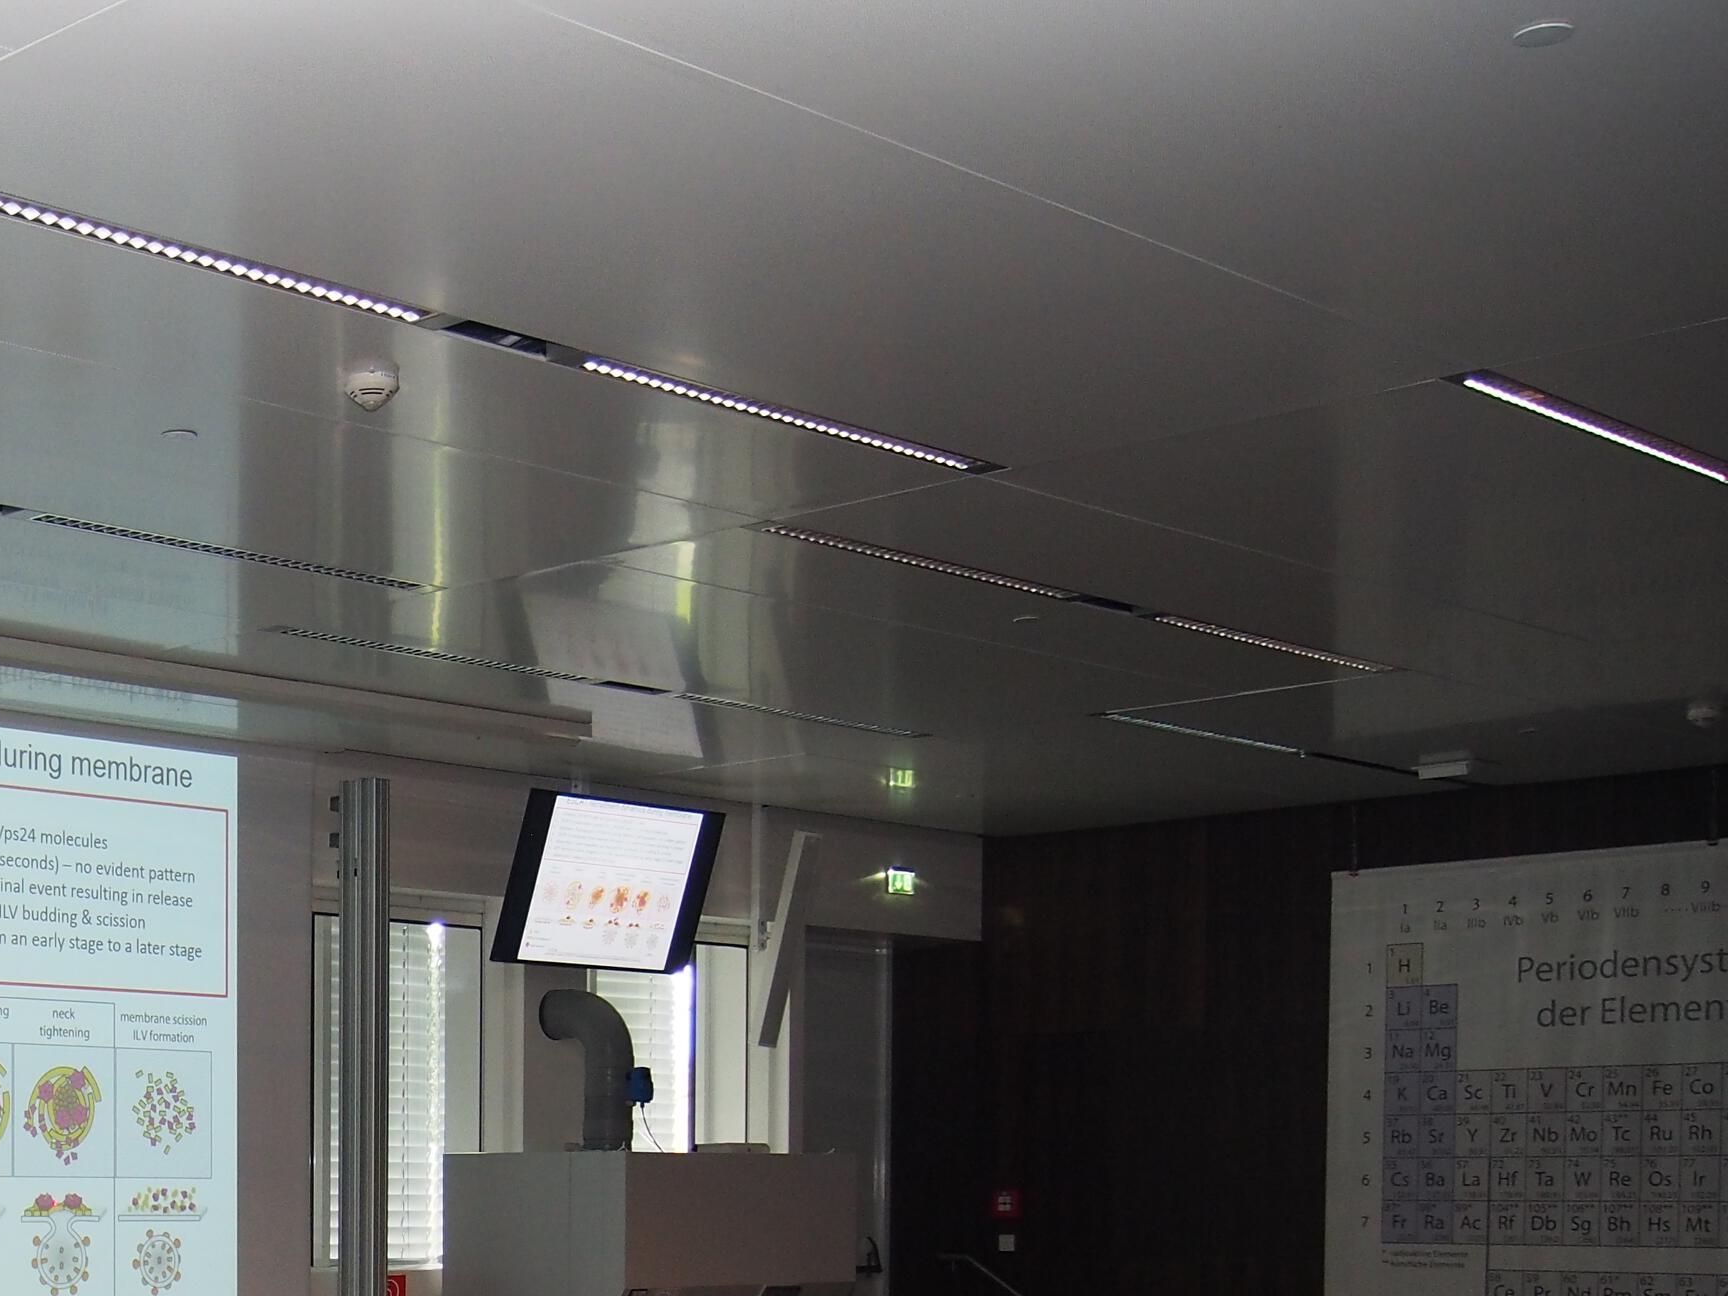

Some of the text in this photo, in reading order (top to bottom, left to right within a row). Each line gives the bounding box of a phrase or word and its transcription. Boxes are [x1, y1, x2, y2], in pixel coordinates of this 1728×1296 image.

[71, 755, 192, 788] membrane
[40, 829, 108, 850] molecules
[0, 854, 59, 875] seconds)
[75, 862, 92, 874] no
[95, 860, 145, 879] evident
[148, 867, 195, 886] pattern
[22, 903, 78, 928] budding
[81, 908, 92, 925] &
[96, 912, 146, 929] scission
[1399, 961, 1410, 973] H
[52, 1007, 75, 1020] neck
[1397, 1000, 1410, 1015] Li
[1429, 1000, 1448, 1014] Be
[1537, 996, 1728, 1028] der Elemen
[120, 1011, 207, 1026] membrane scission
[39, 1024, 90, 1042] tightening
[132, 1029, 194, 1043] ILV formation
[1392, 1045, 1413, 1058] Na
[1425, 1043, 1451, 1061] Mg
[1397, 1087, 1408, 1100] K
[1427, 1086, 1448, 1101] Ca
[1464, 1086, 1482, 1100] Sc
[1503, 1084, 1515, 1098] Ti
[1541, 1084, 1552, 1097] V
[1576, 1083, 1594, 1098] Cr
[1608, 1082, 1636, 1097] Mn
[1652, 1081, 1672, 1096] Fe
[1690, 1079, 1713, 1095] Co
[1467, 1129, 1477, 1142] Y
[1500, 1129, 1516, 1142] Zr
[1533, 1128, 1559, 1142] Nb
[1571, 1128, 1597, 1141] Mo
[1613, 1128, 1630, 1141] Tc
[1650, 1126, 1672, 1141] Ru
[1689, 1125, 1712, 1140] Rh
